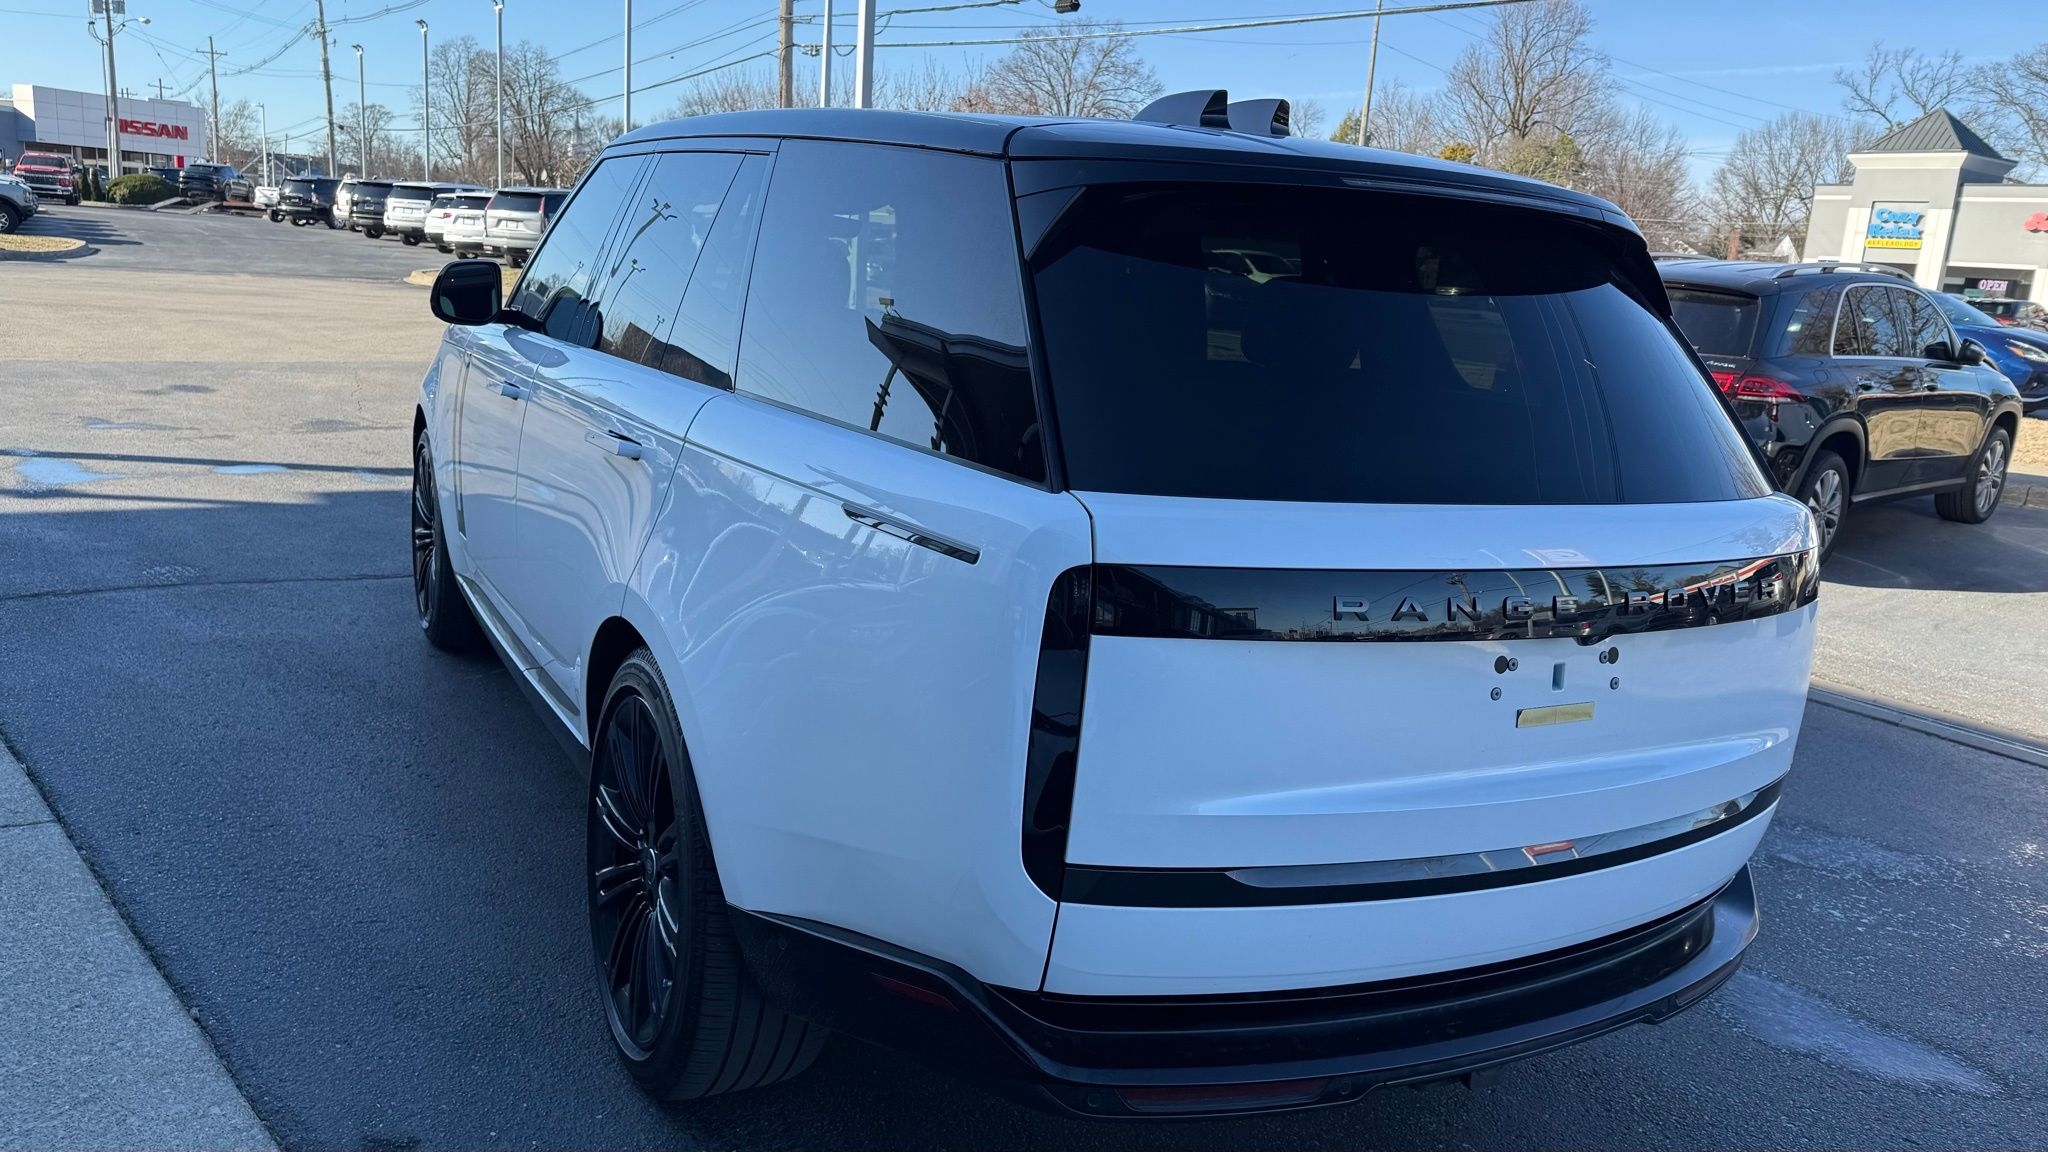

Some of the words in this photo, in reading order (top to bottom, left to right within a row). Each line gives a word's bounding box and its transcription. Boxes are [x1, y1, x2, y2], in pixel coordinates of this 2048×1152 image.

[1868, 223, 1921, 238] Relax
[1978, 279, 2008, 291] OPEN
[1333, 595, 1579, 622] RANGE
[1624, 577, 1777, 616] ROVER
